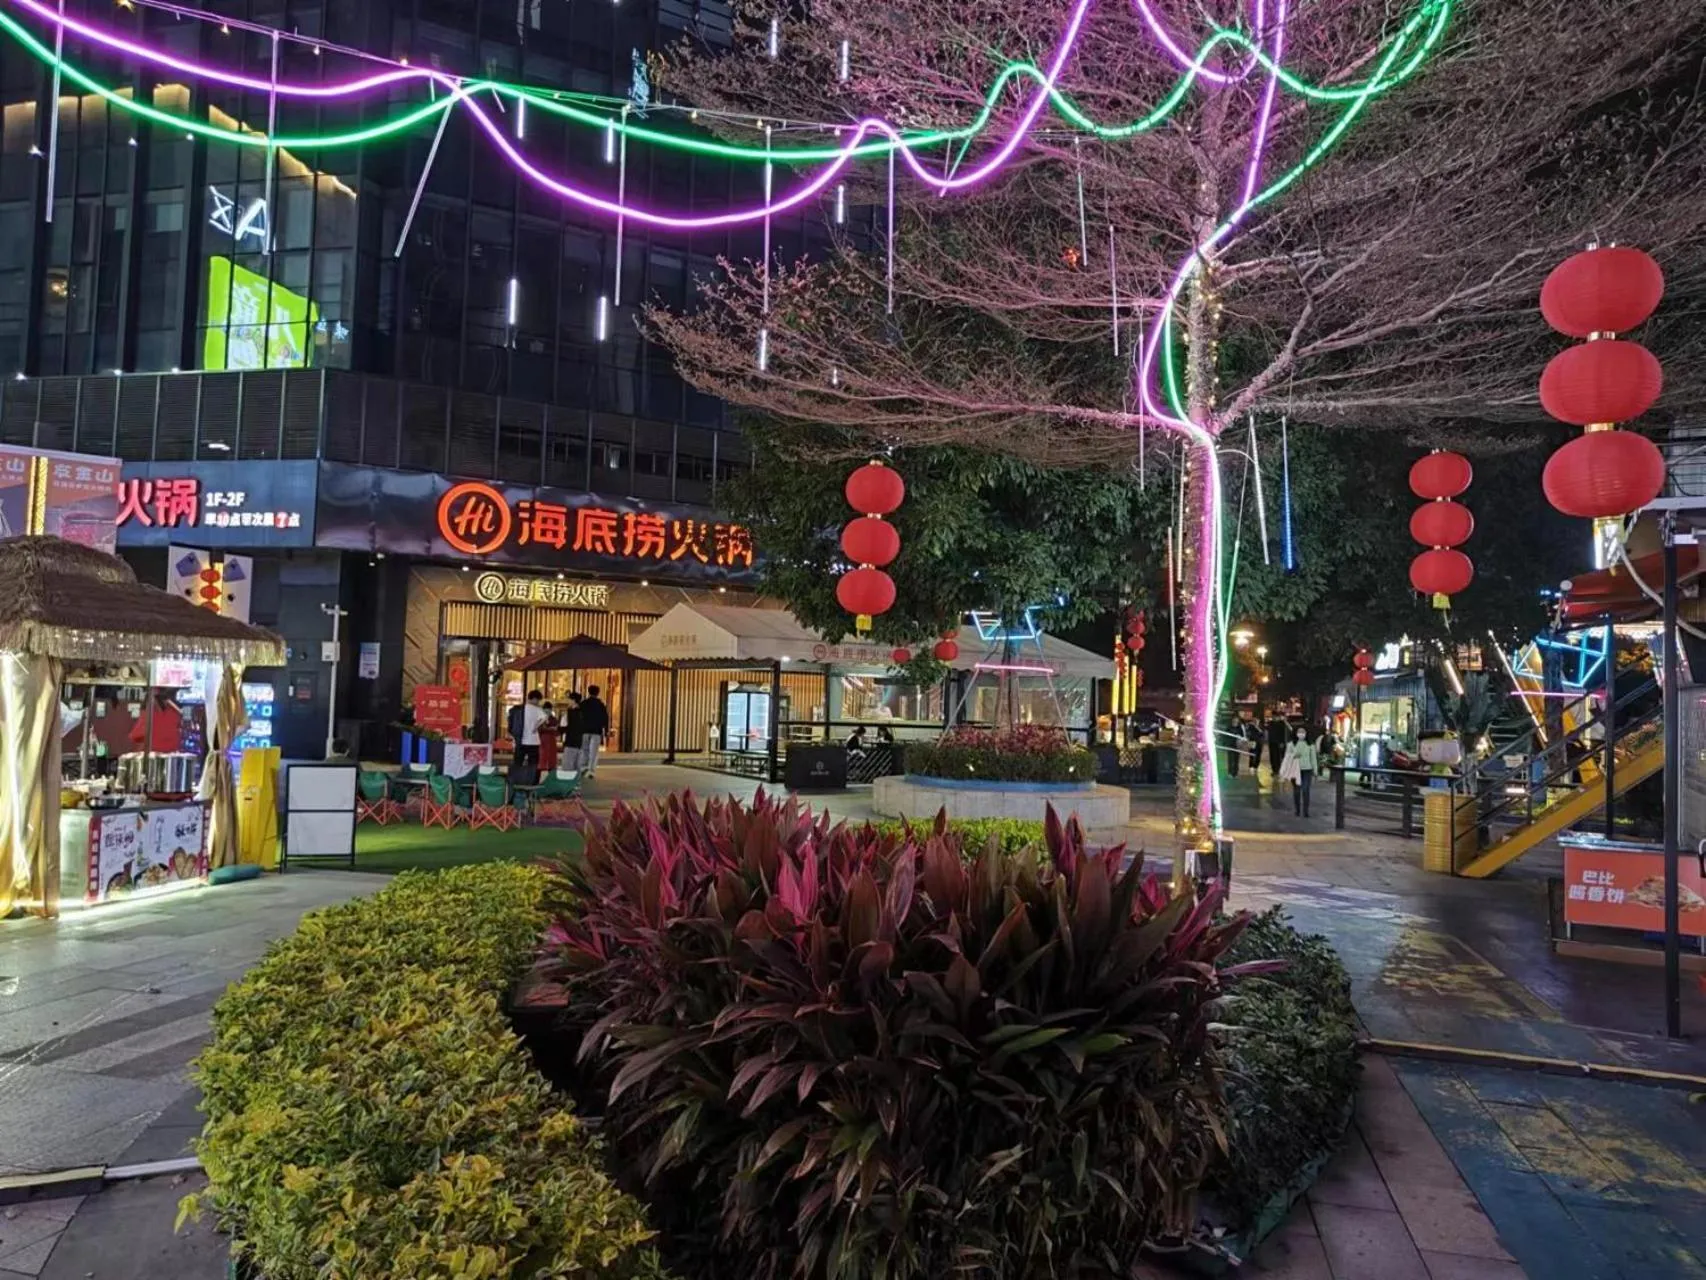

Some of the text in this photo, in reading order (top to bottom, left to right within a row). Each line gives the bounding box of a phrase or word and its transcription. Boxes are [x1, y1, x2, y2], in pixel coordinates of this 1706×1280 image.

[115, 479, 198, 528] 火锅
[204, 491, 246, 507] 1F-2F
[517, 501, 755, 568] 海底捞火锅
[507, 578, 609, 607] 海底捞火锅
[1582, 869, 1615, 886] 巴比
